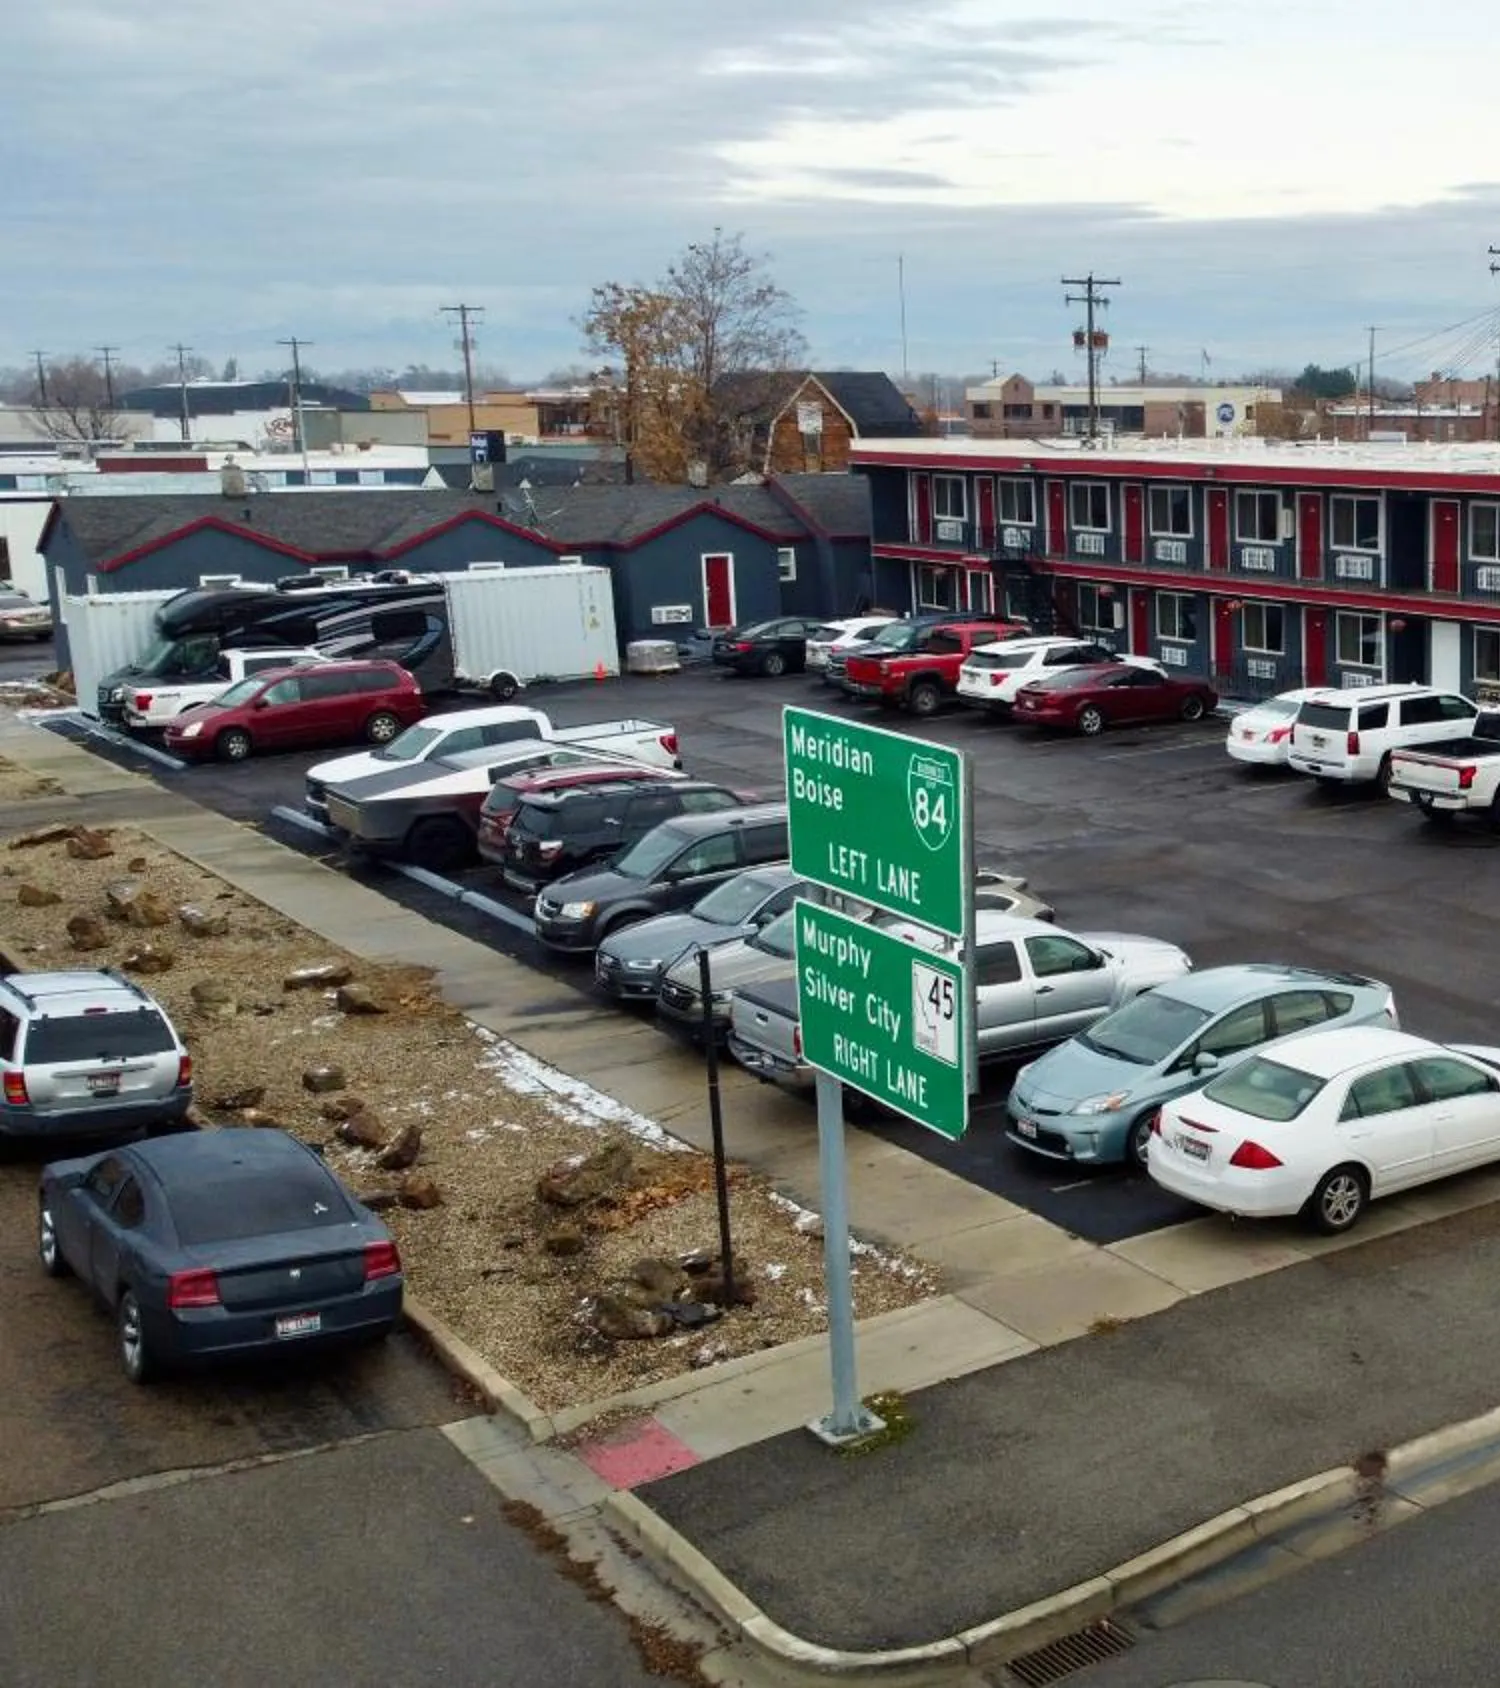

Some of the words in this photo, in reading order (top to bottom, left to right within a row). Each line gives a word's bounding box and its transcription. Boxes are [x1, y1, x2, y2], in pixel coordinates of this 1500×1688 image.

[791, 726, 873, 777] Meridian
[793, 773, 843, 811] Boise
[915, 787, 946, 834] 84
[829, 842, 868, 884] LEFT
[877, 858, 921, 905] LANE
[803, 916, 871, 978] Murphy
[805, 967, 855, 1015] Silver
[866, 993, 901, 1042] City
[928, 976, 953, 1020] 45
[834, 1032, 878, 1086] RIGHT
[887, 1065, 929, 1109] LANE
